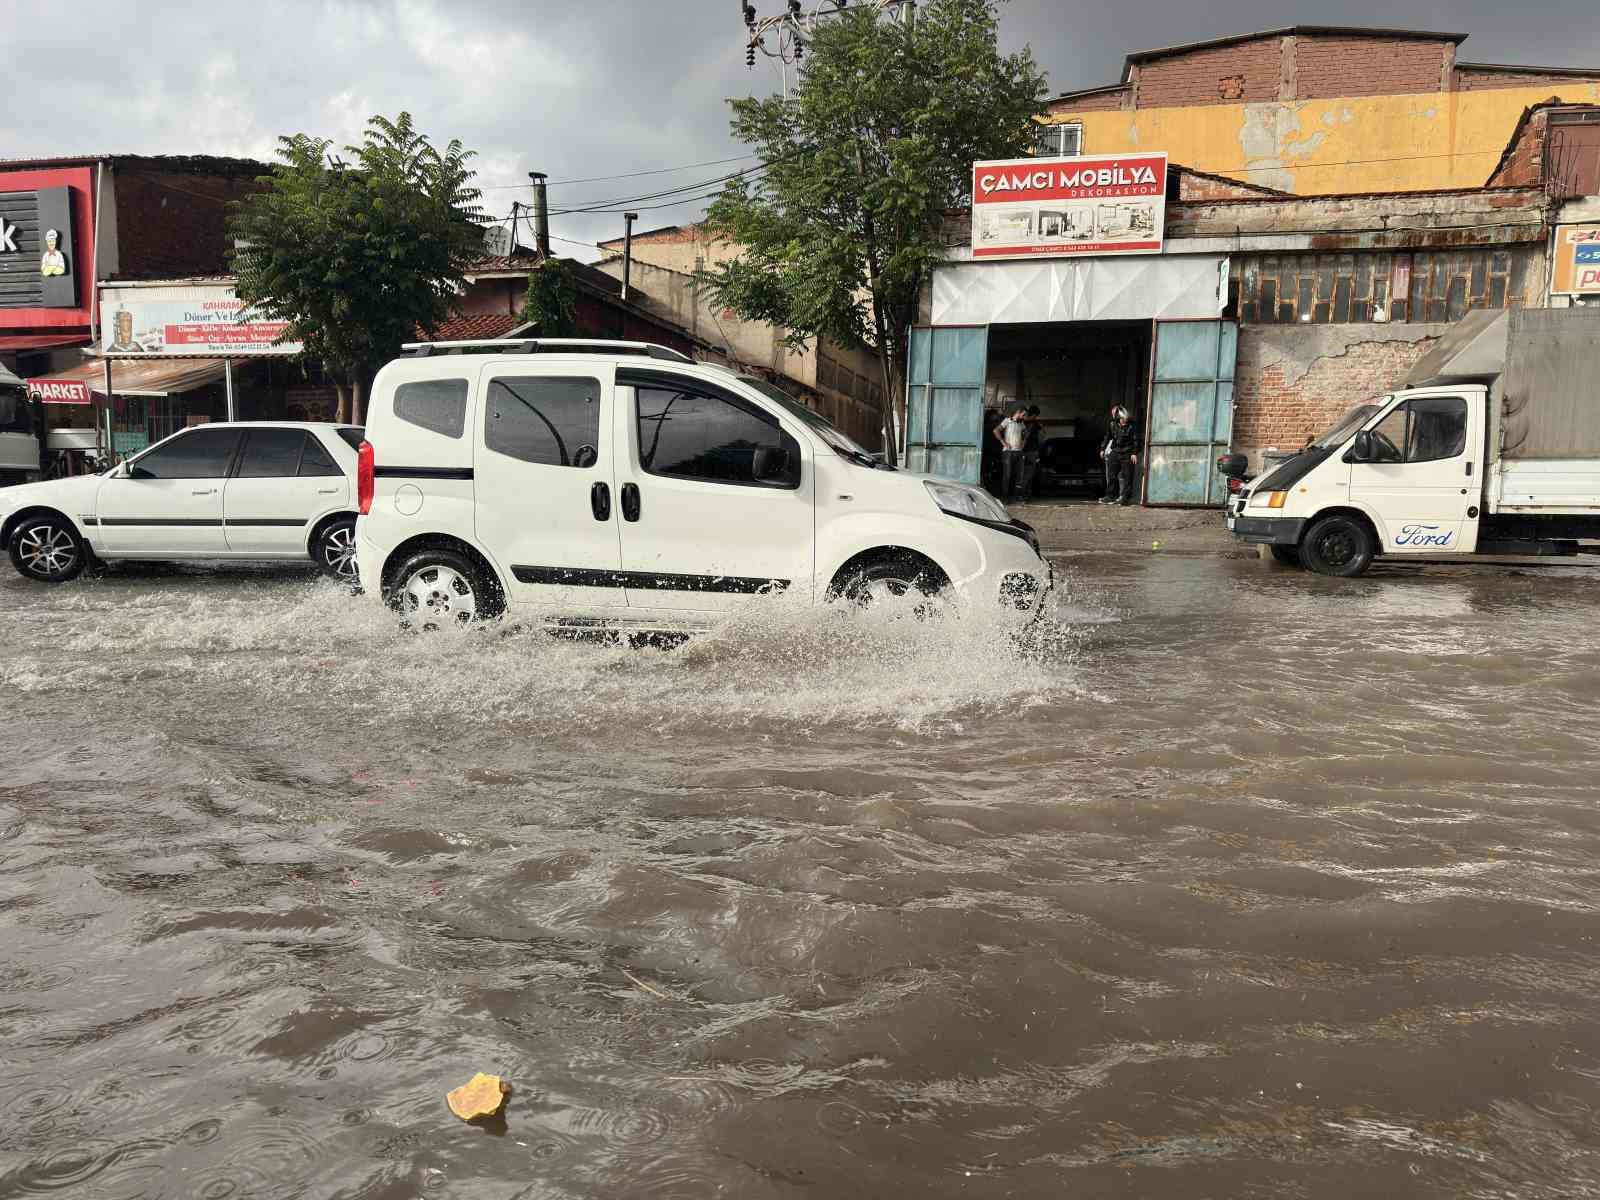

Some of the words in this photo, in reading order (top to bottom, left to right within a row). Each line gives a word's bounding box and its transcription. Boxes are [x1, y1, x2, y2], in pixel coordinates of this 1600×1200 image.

[980, 171, 1054, 195] ÇAMCI
[1060, 162, 1157, 188] MOBİLYA
[1071, 187, 1157, 198] DEKORASYON
[29, 382, 84, 400] MARKET
[1395, 524, 1453, 546] Ford
